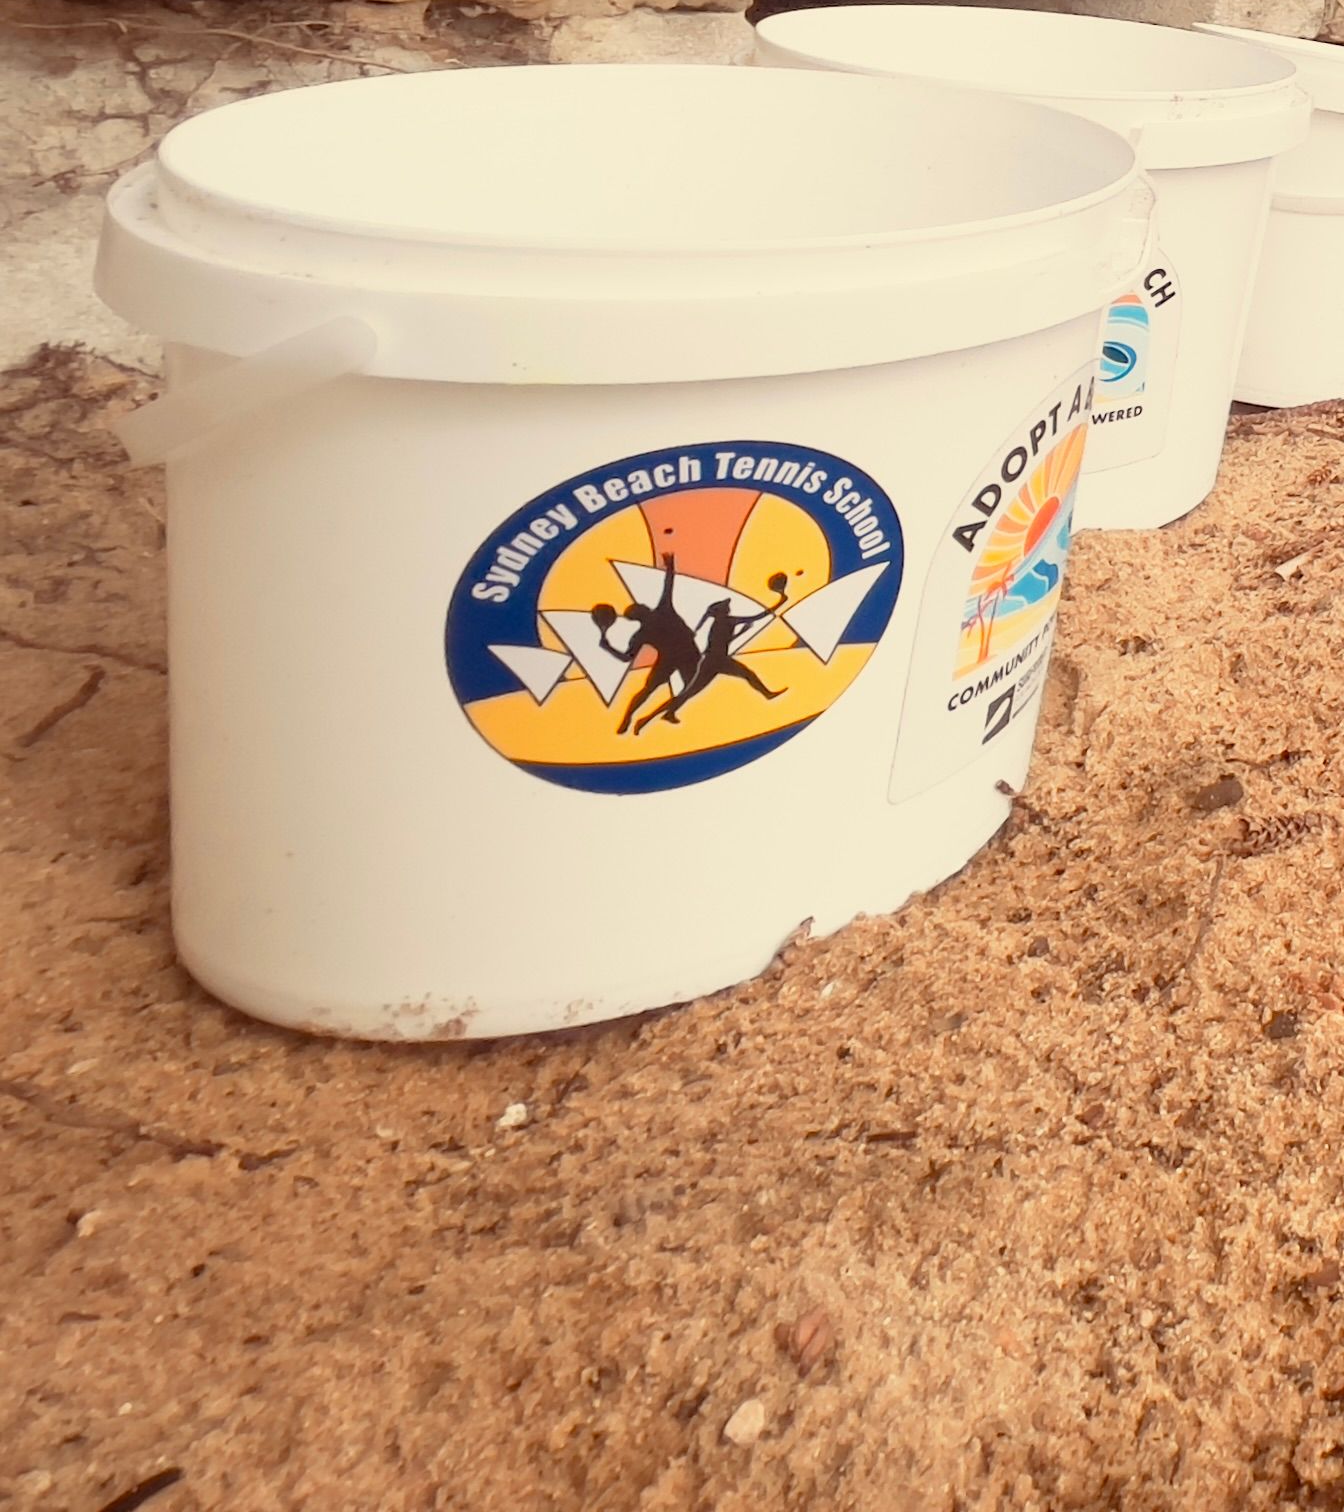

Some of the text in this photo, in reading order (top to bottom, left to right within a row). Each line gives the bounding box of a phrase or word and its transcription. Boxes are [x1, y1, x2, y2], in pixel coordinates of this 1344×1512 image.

[952, 384, 1082, 553] ADOPT A
[1092, 405, 1143, 425] WERED
[472, 452, 891, 603] Sydney Beach Tennis School
[947, 635, 1040, 712] COMMUNITY
